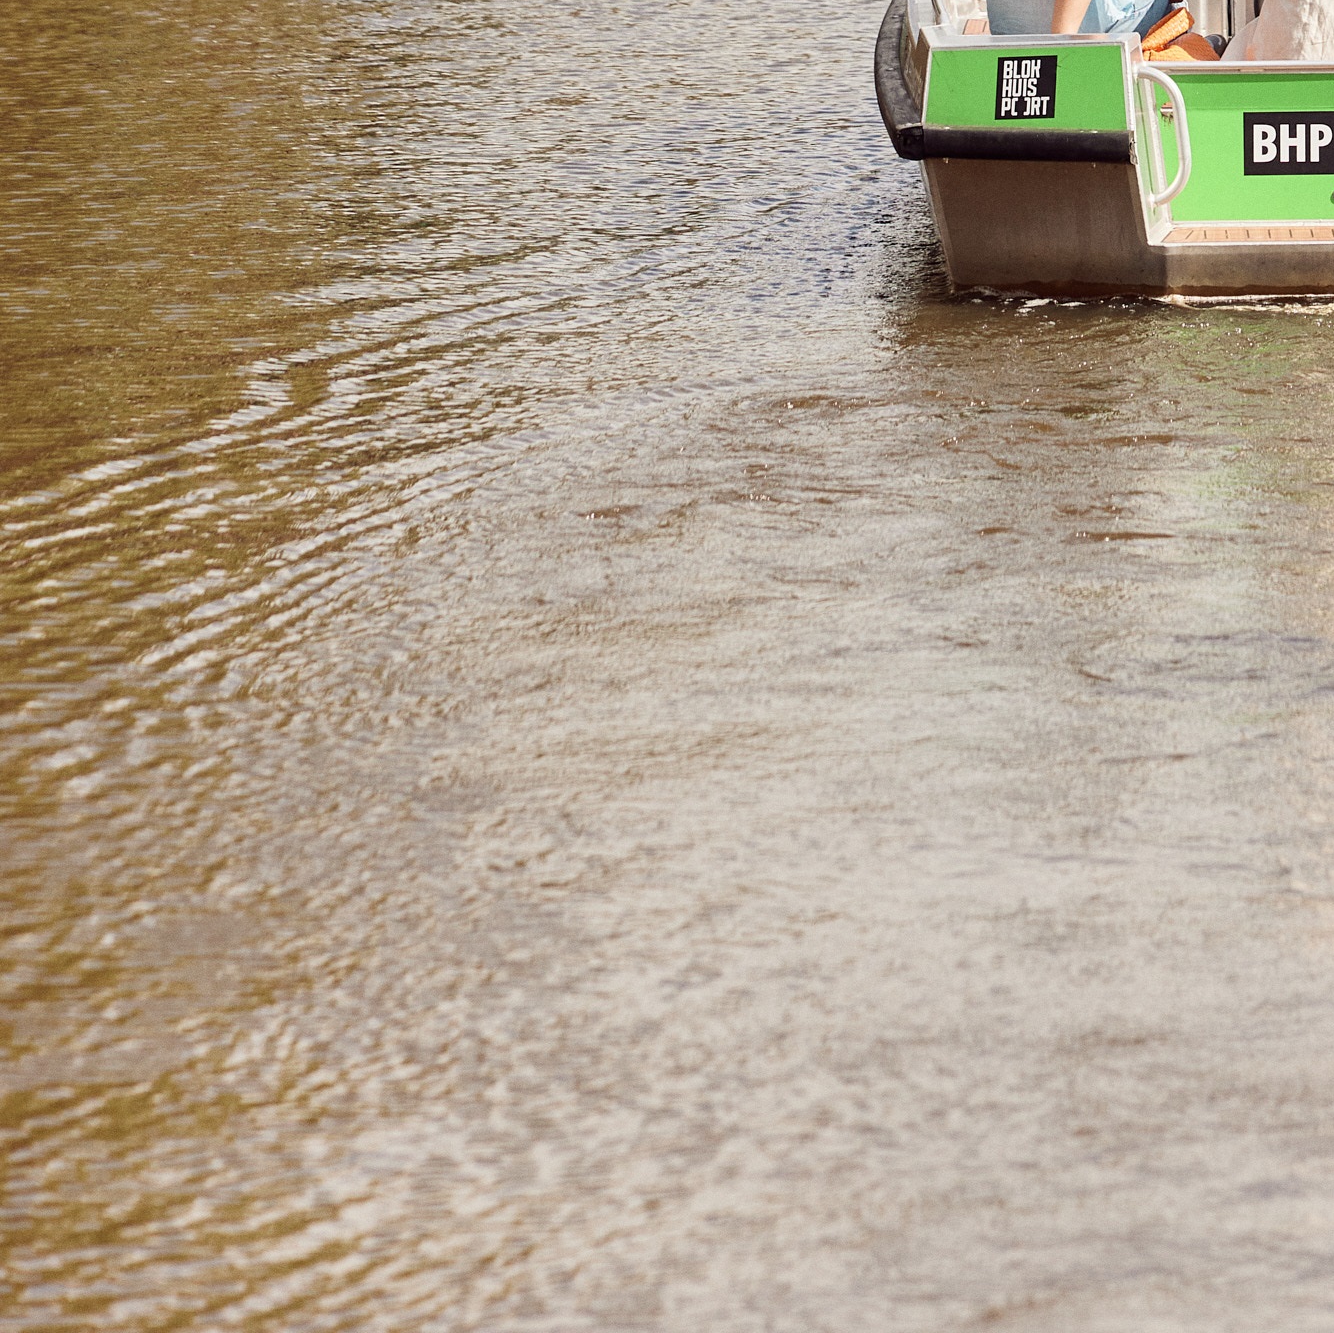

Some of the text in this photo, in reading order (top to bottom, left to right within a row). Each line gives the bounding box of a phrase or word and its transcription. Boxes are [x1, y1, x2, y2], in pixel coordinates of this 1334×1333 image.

[1003, 59, 1041, 79] BLOK
[1002, 78, 1038, 98] HUIS
[1252, 123, 1333, 163] BHP
